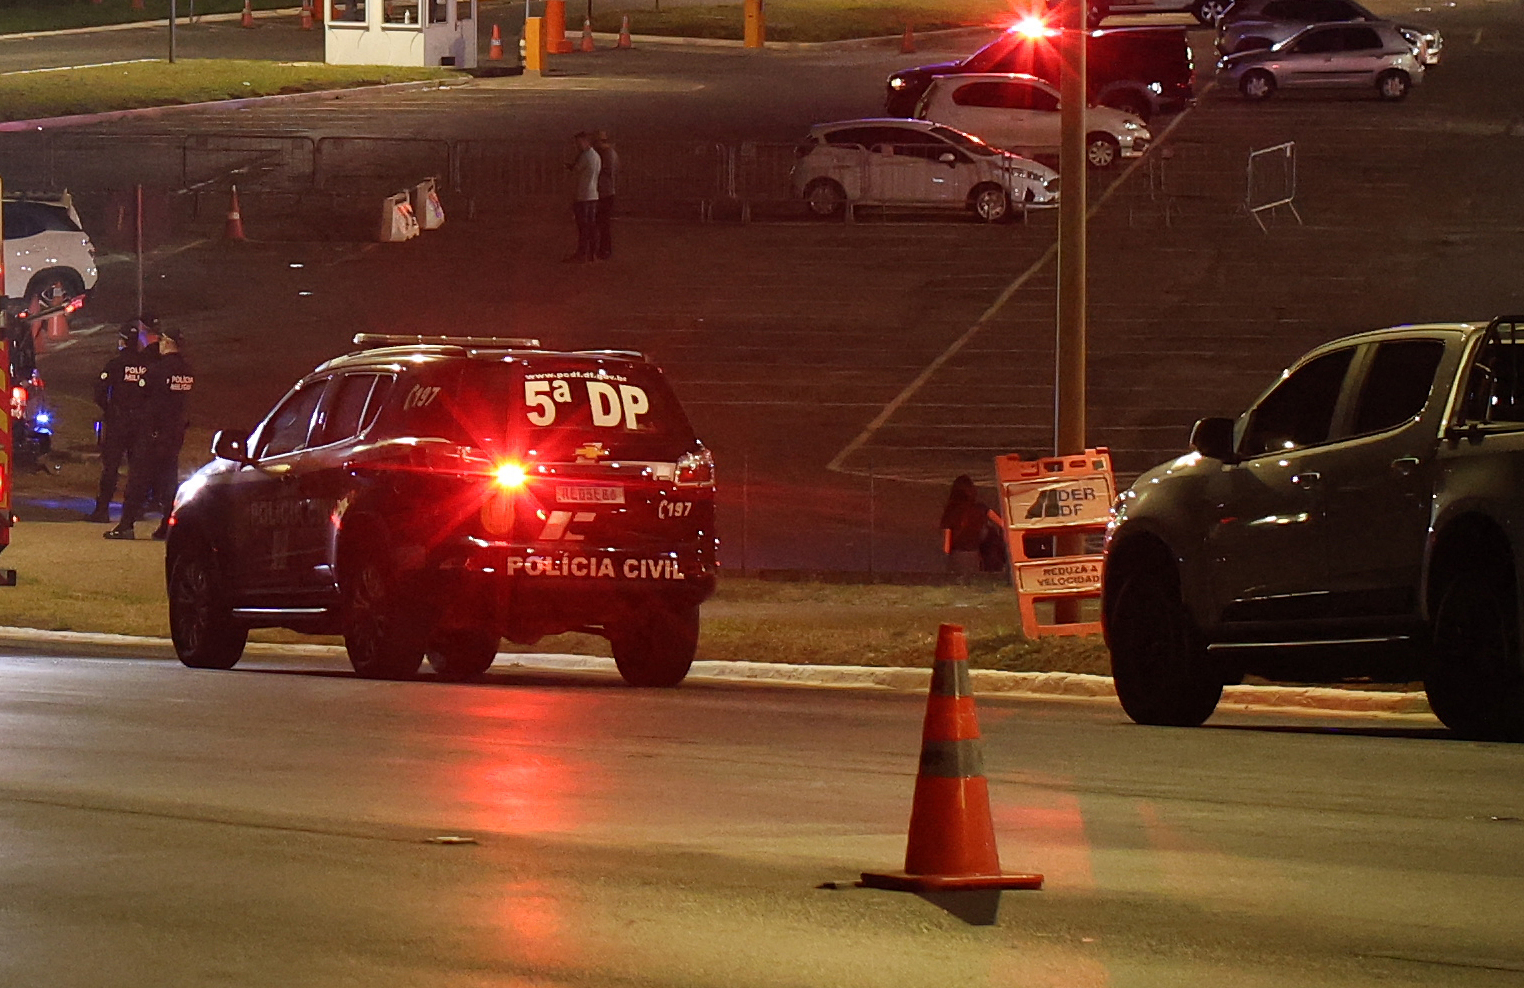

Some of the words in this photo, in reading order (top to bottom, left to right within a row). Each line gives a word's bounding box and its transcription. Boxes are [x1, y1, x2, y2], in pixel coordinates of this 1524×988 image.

[411, 384, 441, 407] 197
[586, 381, 649, 430] DP
[1058, 487, 1096, 502] DER
[666, 502, 692, 517] 197
[1060, 503, 1083, 517] DF
[506, 552, 616, 578] POLÍCIA
[623, 558, 685, 580] CIVIL
[1043, 565, 1088, 576] REDUZA
[1036, 575, 1100, 586] VELOCIDAD
